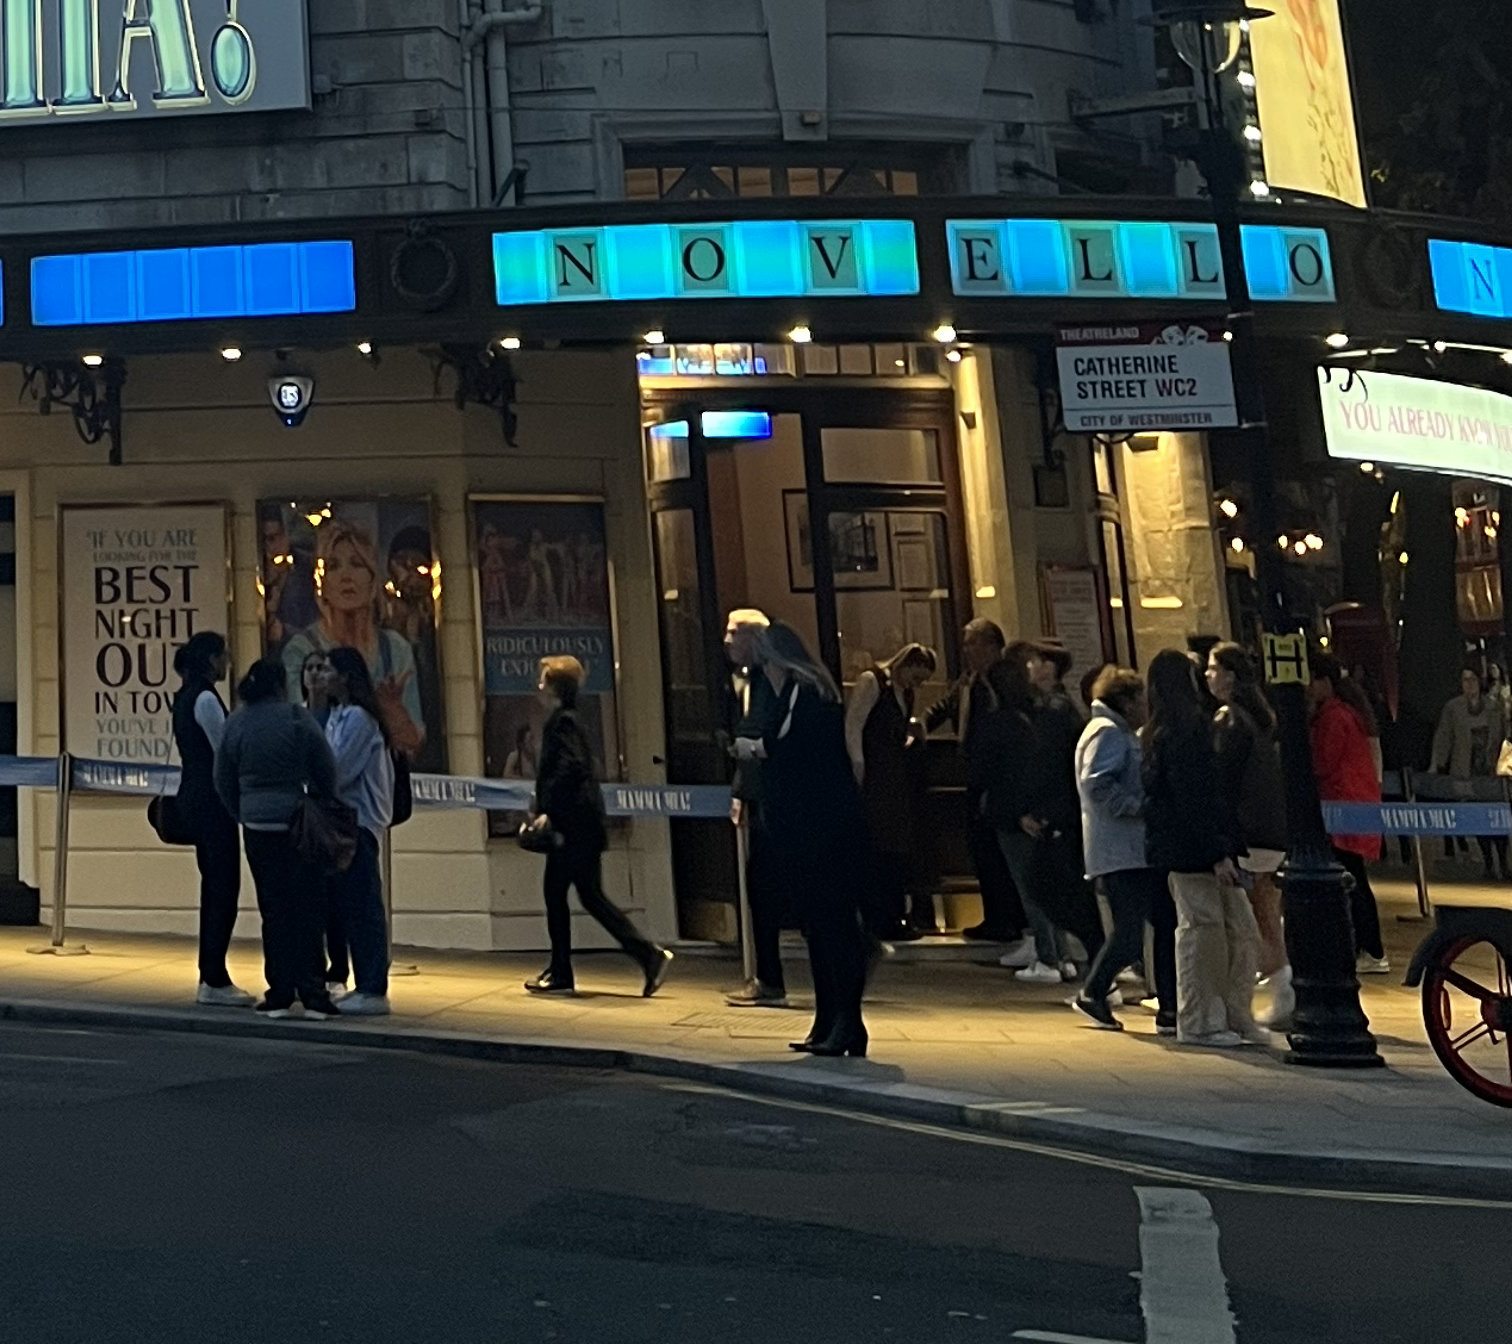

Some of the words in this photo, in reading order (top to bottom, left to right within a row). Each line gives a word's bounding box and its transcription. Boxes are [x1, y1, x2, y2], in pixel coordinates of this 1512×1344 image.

[1061, 327, 1139, 341] THEATRELAND
[1074, 355, 1178, 376] CATHERINE
[1077, 379, 1146, 399] STREET
[1155, 378, 1197, 397] WC2
[1080, 415, 1105, 427] CITY
[1110, 414, 1123, 426] OF
[1129, 412, 1212, 425] WESTMINSTER
[1339, 400, 1381, 431] YOU
[1388, 406, 1454, 440] ALREADY
[115, 529, 154, 548] YOU
[163, 528, 197, 546] ARE
[95, 565, 199, 604] BEST
[95, 608, 199, 640] NIGHT
[95, 692, 118, 714] IN
[96, 718, 157, 735] YOU'VE
[98, 738, 169, 758] FOUND
[1380, 809, 1427, 829] MAMMA
